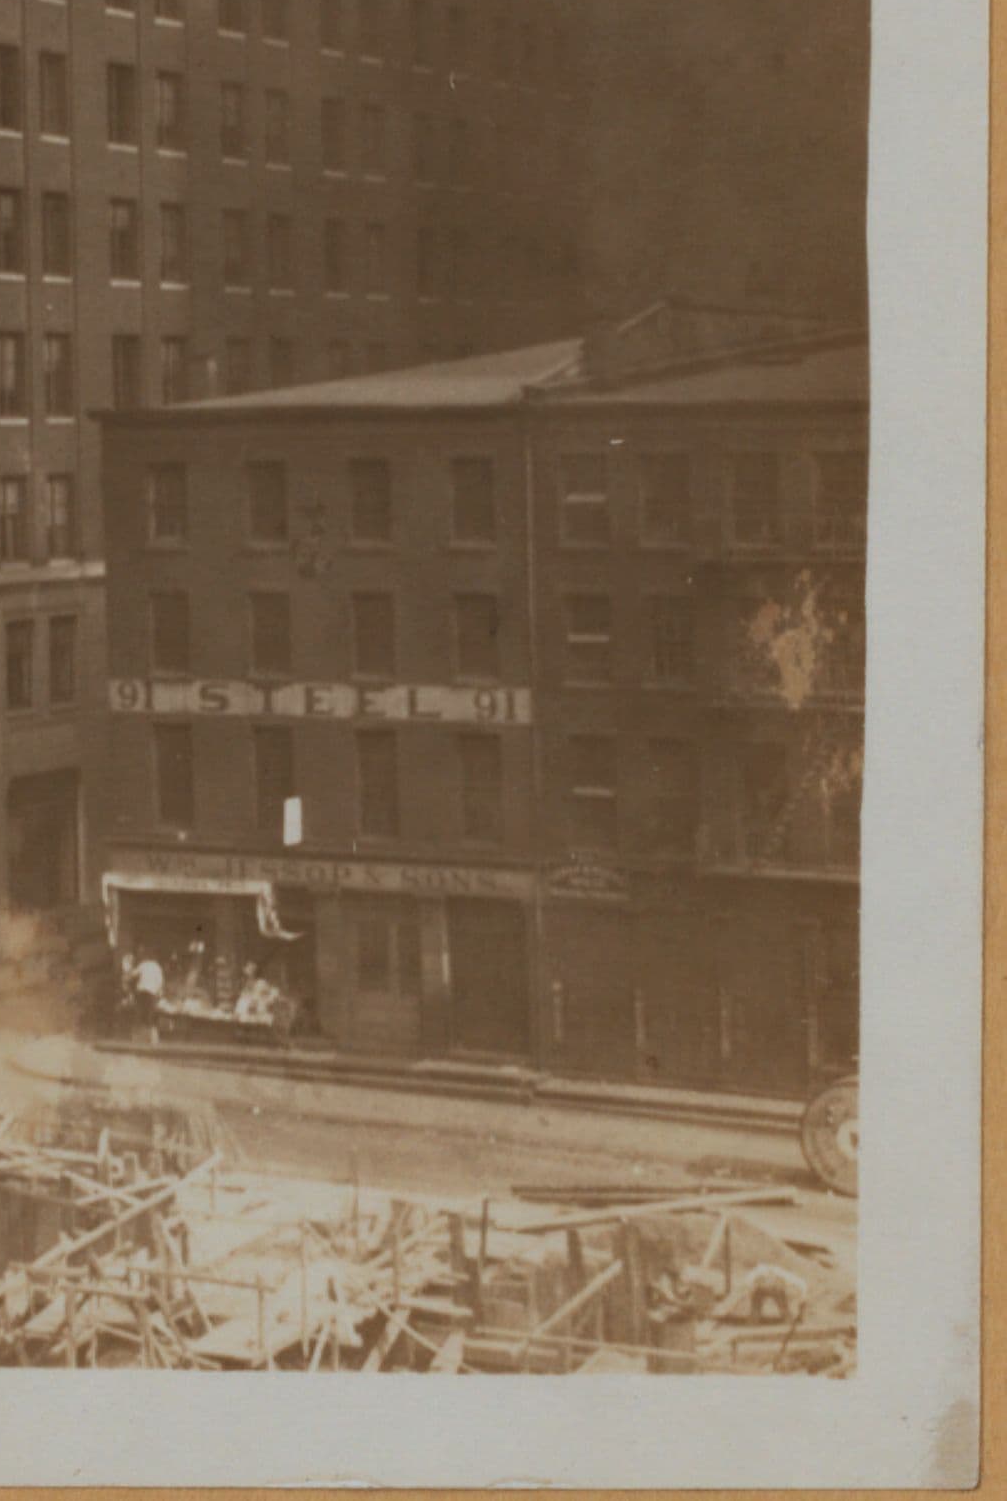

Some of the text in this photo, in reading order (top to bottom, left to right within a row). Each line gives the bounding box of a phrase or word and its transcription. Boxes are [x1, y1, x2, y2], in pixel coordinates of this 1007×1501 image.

[116, 681, 517, 722] 91 STEEL 91
[400, 865, 498, 891] SONS
